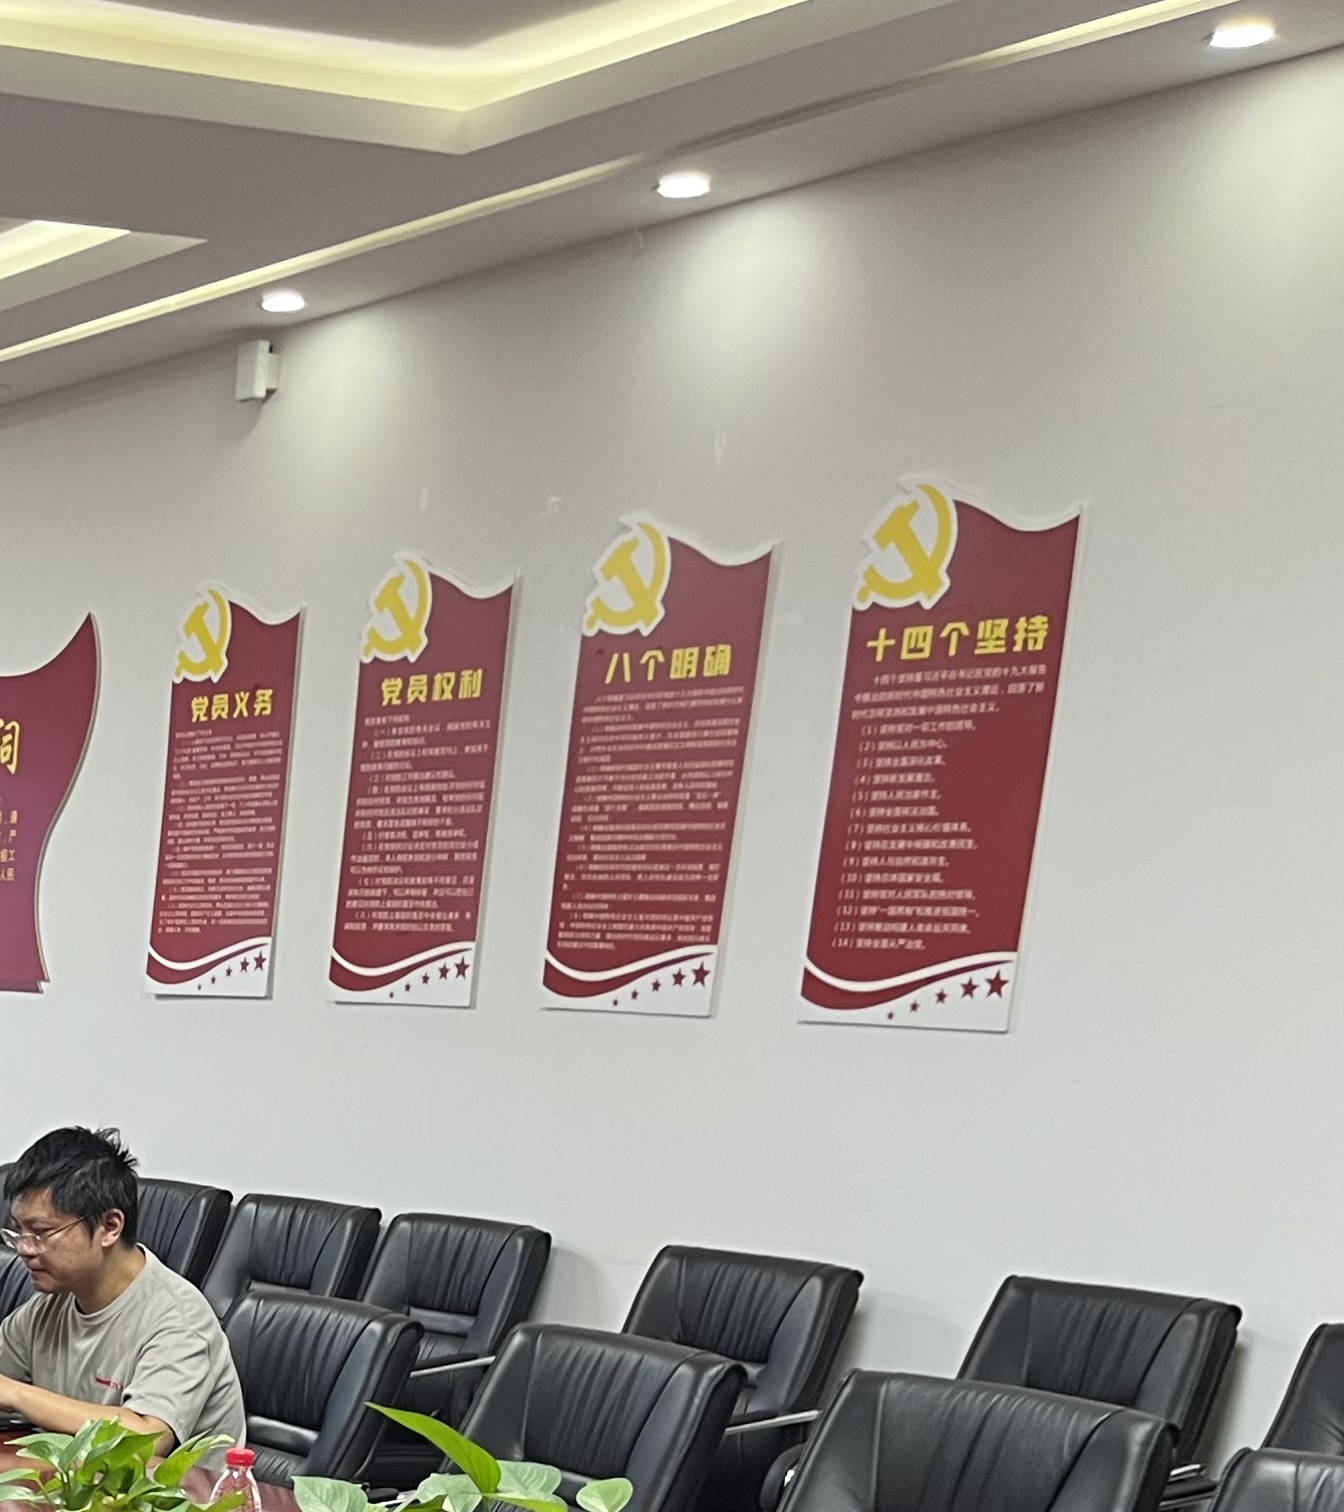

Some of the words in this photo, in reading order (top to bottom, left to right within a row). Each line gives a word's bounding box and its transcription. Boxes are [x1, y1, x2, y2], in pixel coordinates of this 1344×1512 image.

[866, 615, 1049, 662] 十四个坚持
[605, 644, 731, 684] 八个明确
[191, 688, 273, 722] 党员义务
[381, 668, 482, 706] 党员权利
